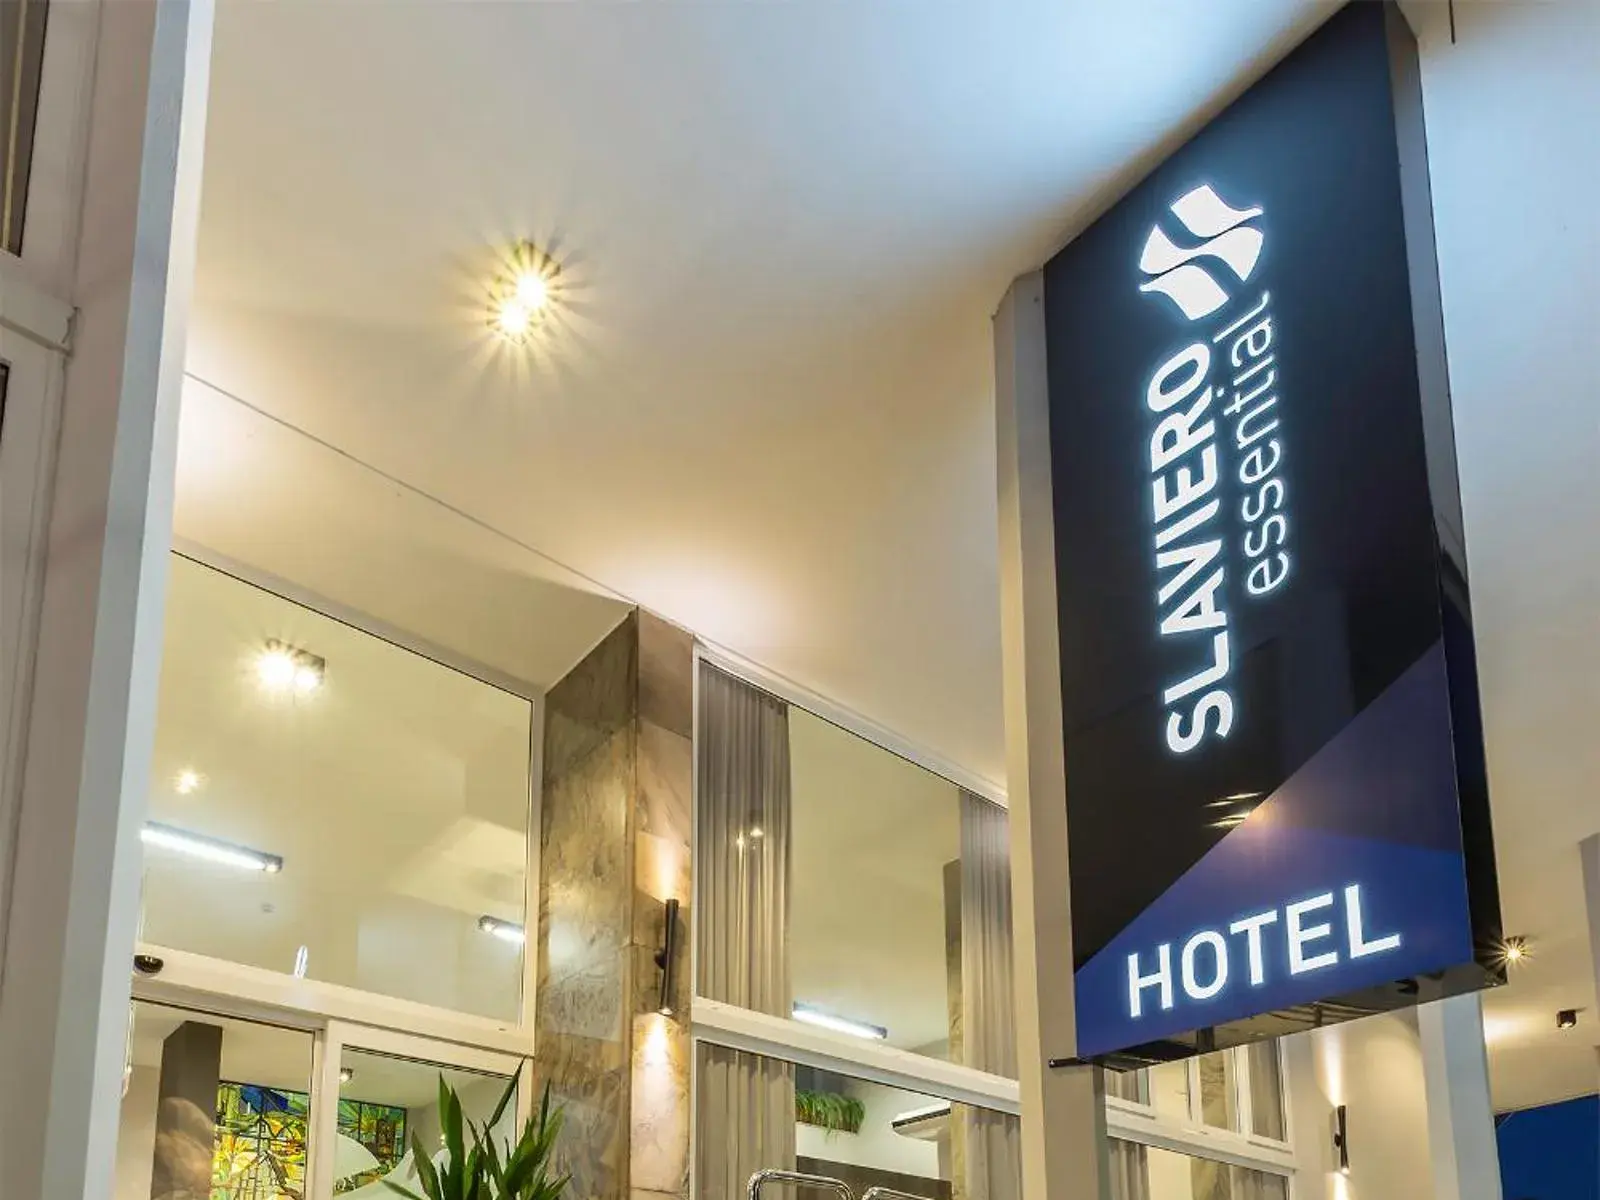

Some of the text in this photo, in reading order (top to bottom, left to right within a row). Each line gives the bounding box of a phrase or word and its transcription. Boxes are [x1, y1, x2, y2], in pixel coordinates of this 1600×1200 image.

[1146, 340, 1234, 754] SLAVIERO
[1212, 289, 1290, 596] essential
[1126, 882, 1402, 1019] HOTEL
